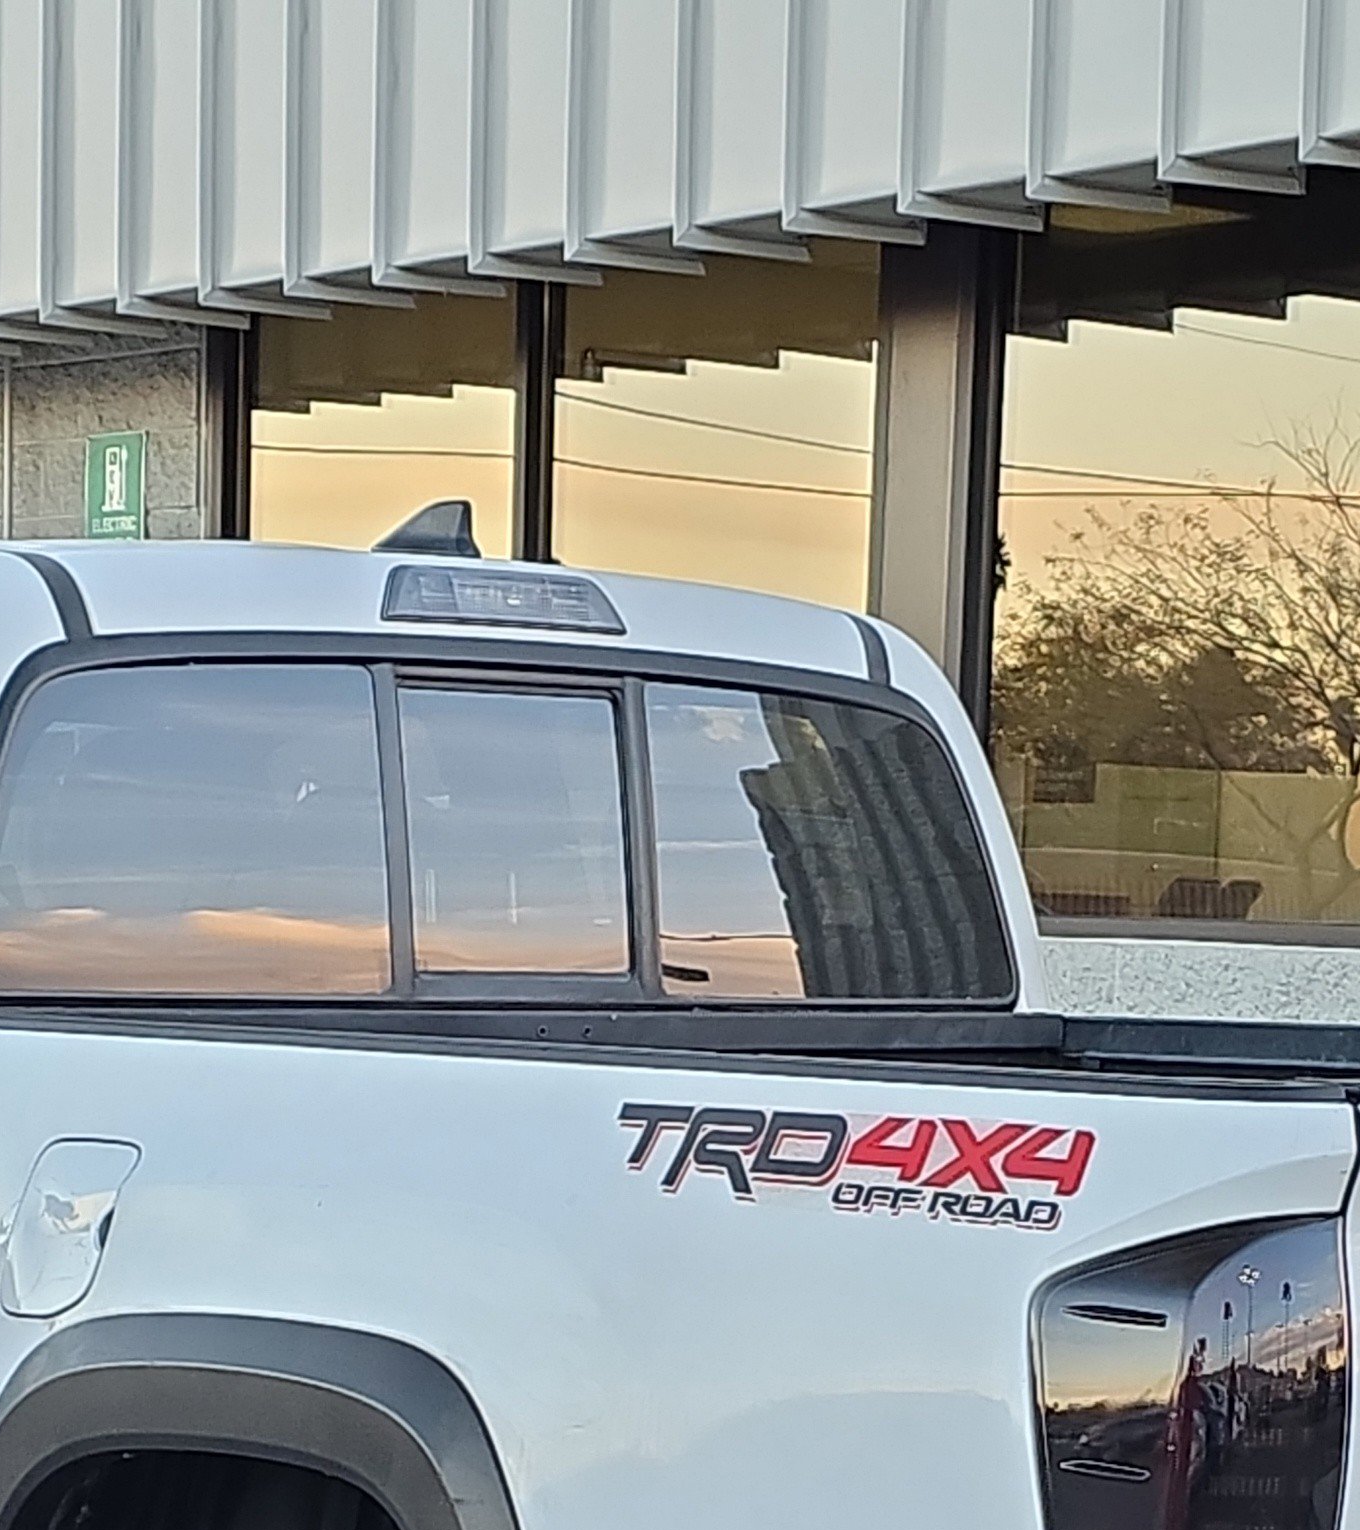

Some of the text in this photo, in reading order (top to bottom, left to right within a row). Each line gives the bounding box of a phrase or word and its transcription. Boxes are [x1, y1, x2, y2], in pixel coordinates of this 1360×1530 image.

[617, 1102, 848, 1202] TRD
[831, 1183, 1064, 1231] OFF ROAD
